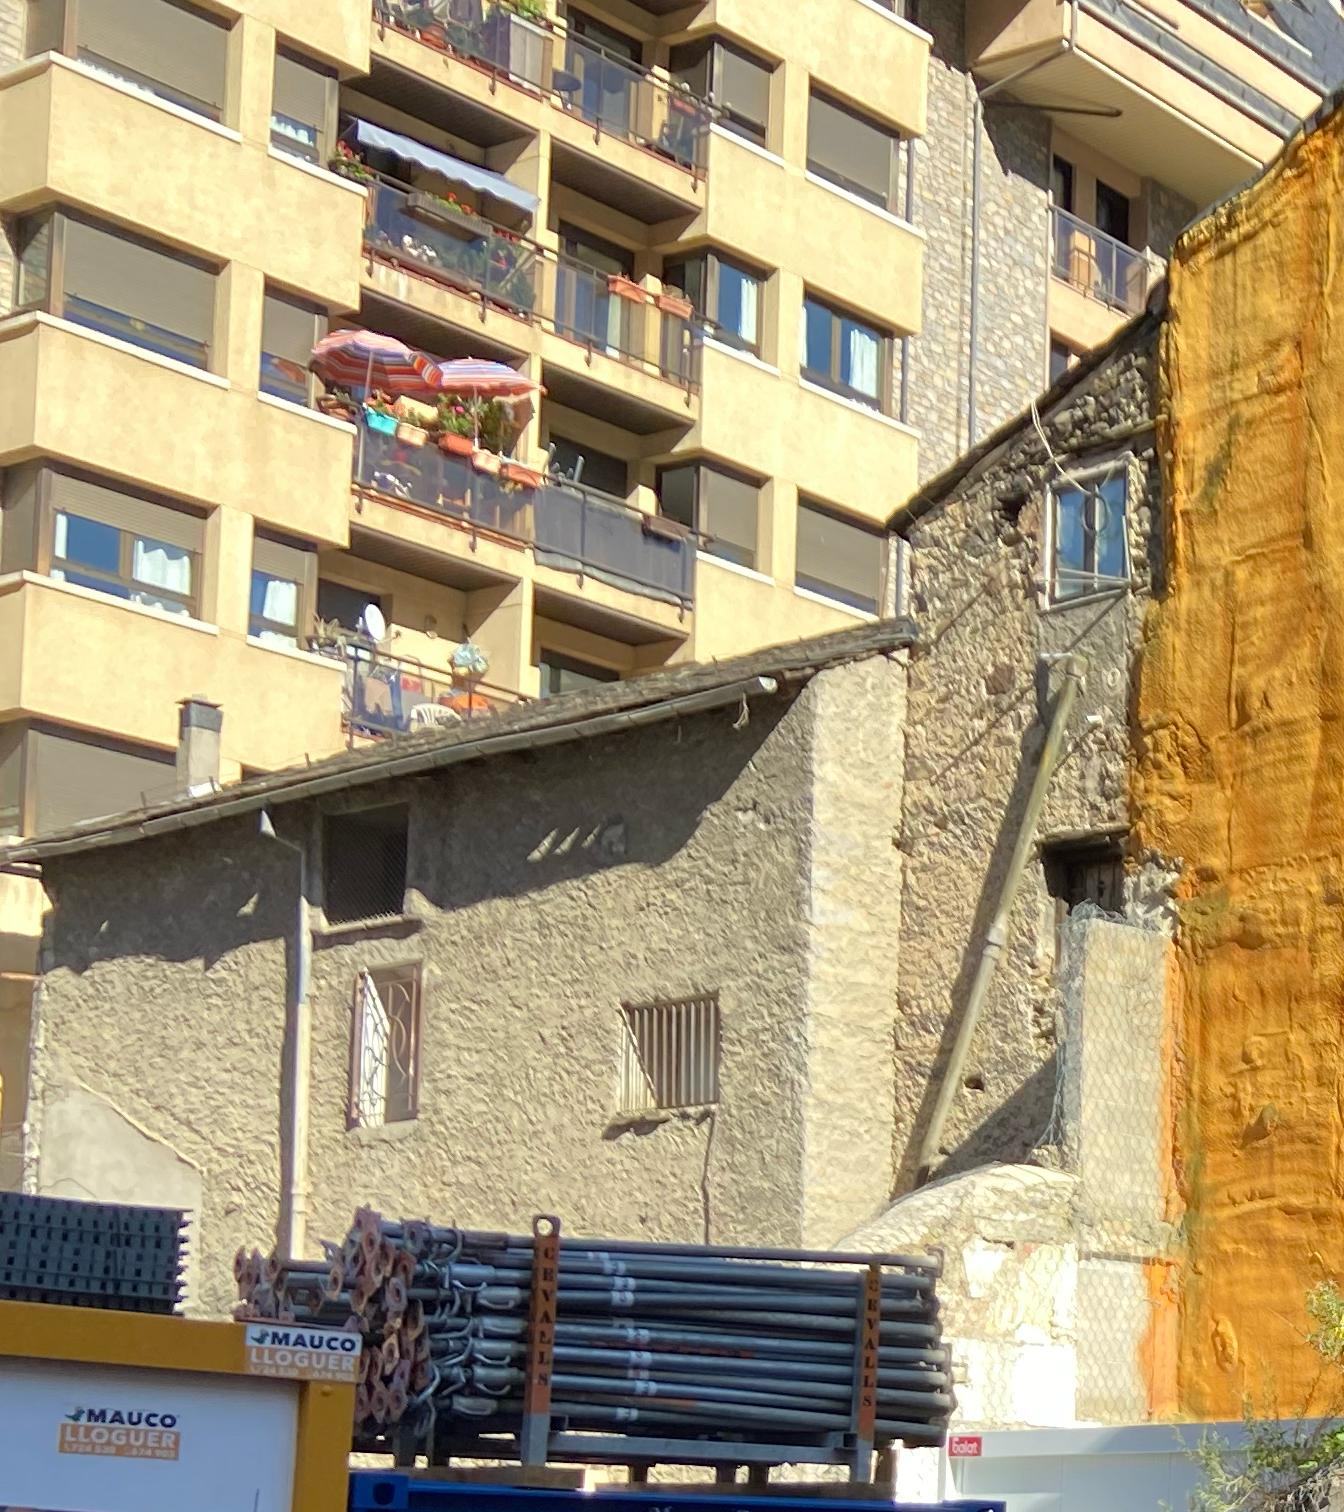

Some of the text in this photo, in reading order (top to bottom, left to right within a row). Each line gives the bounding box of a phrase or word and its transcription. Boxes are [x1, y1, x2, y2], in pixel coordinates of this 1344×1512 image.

[270, 1331, 356, 1352] MAUCO
[863, 1279, 879, 1407] CEVALLS
[251, 1348, 354, 1371] LLOGUER
[86, 1408, 177, 1428] MAUCO
[65, 1426, 176, 1448] LLOGUER
